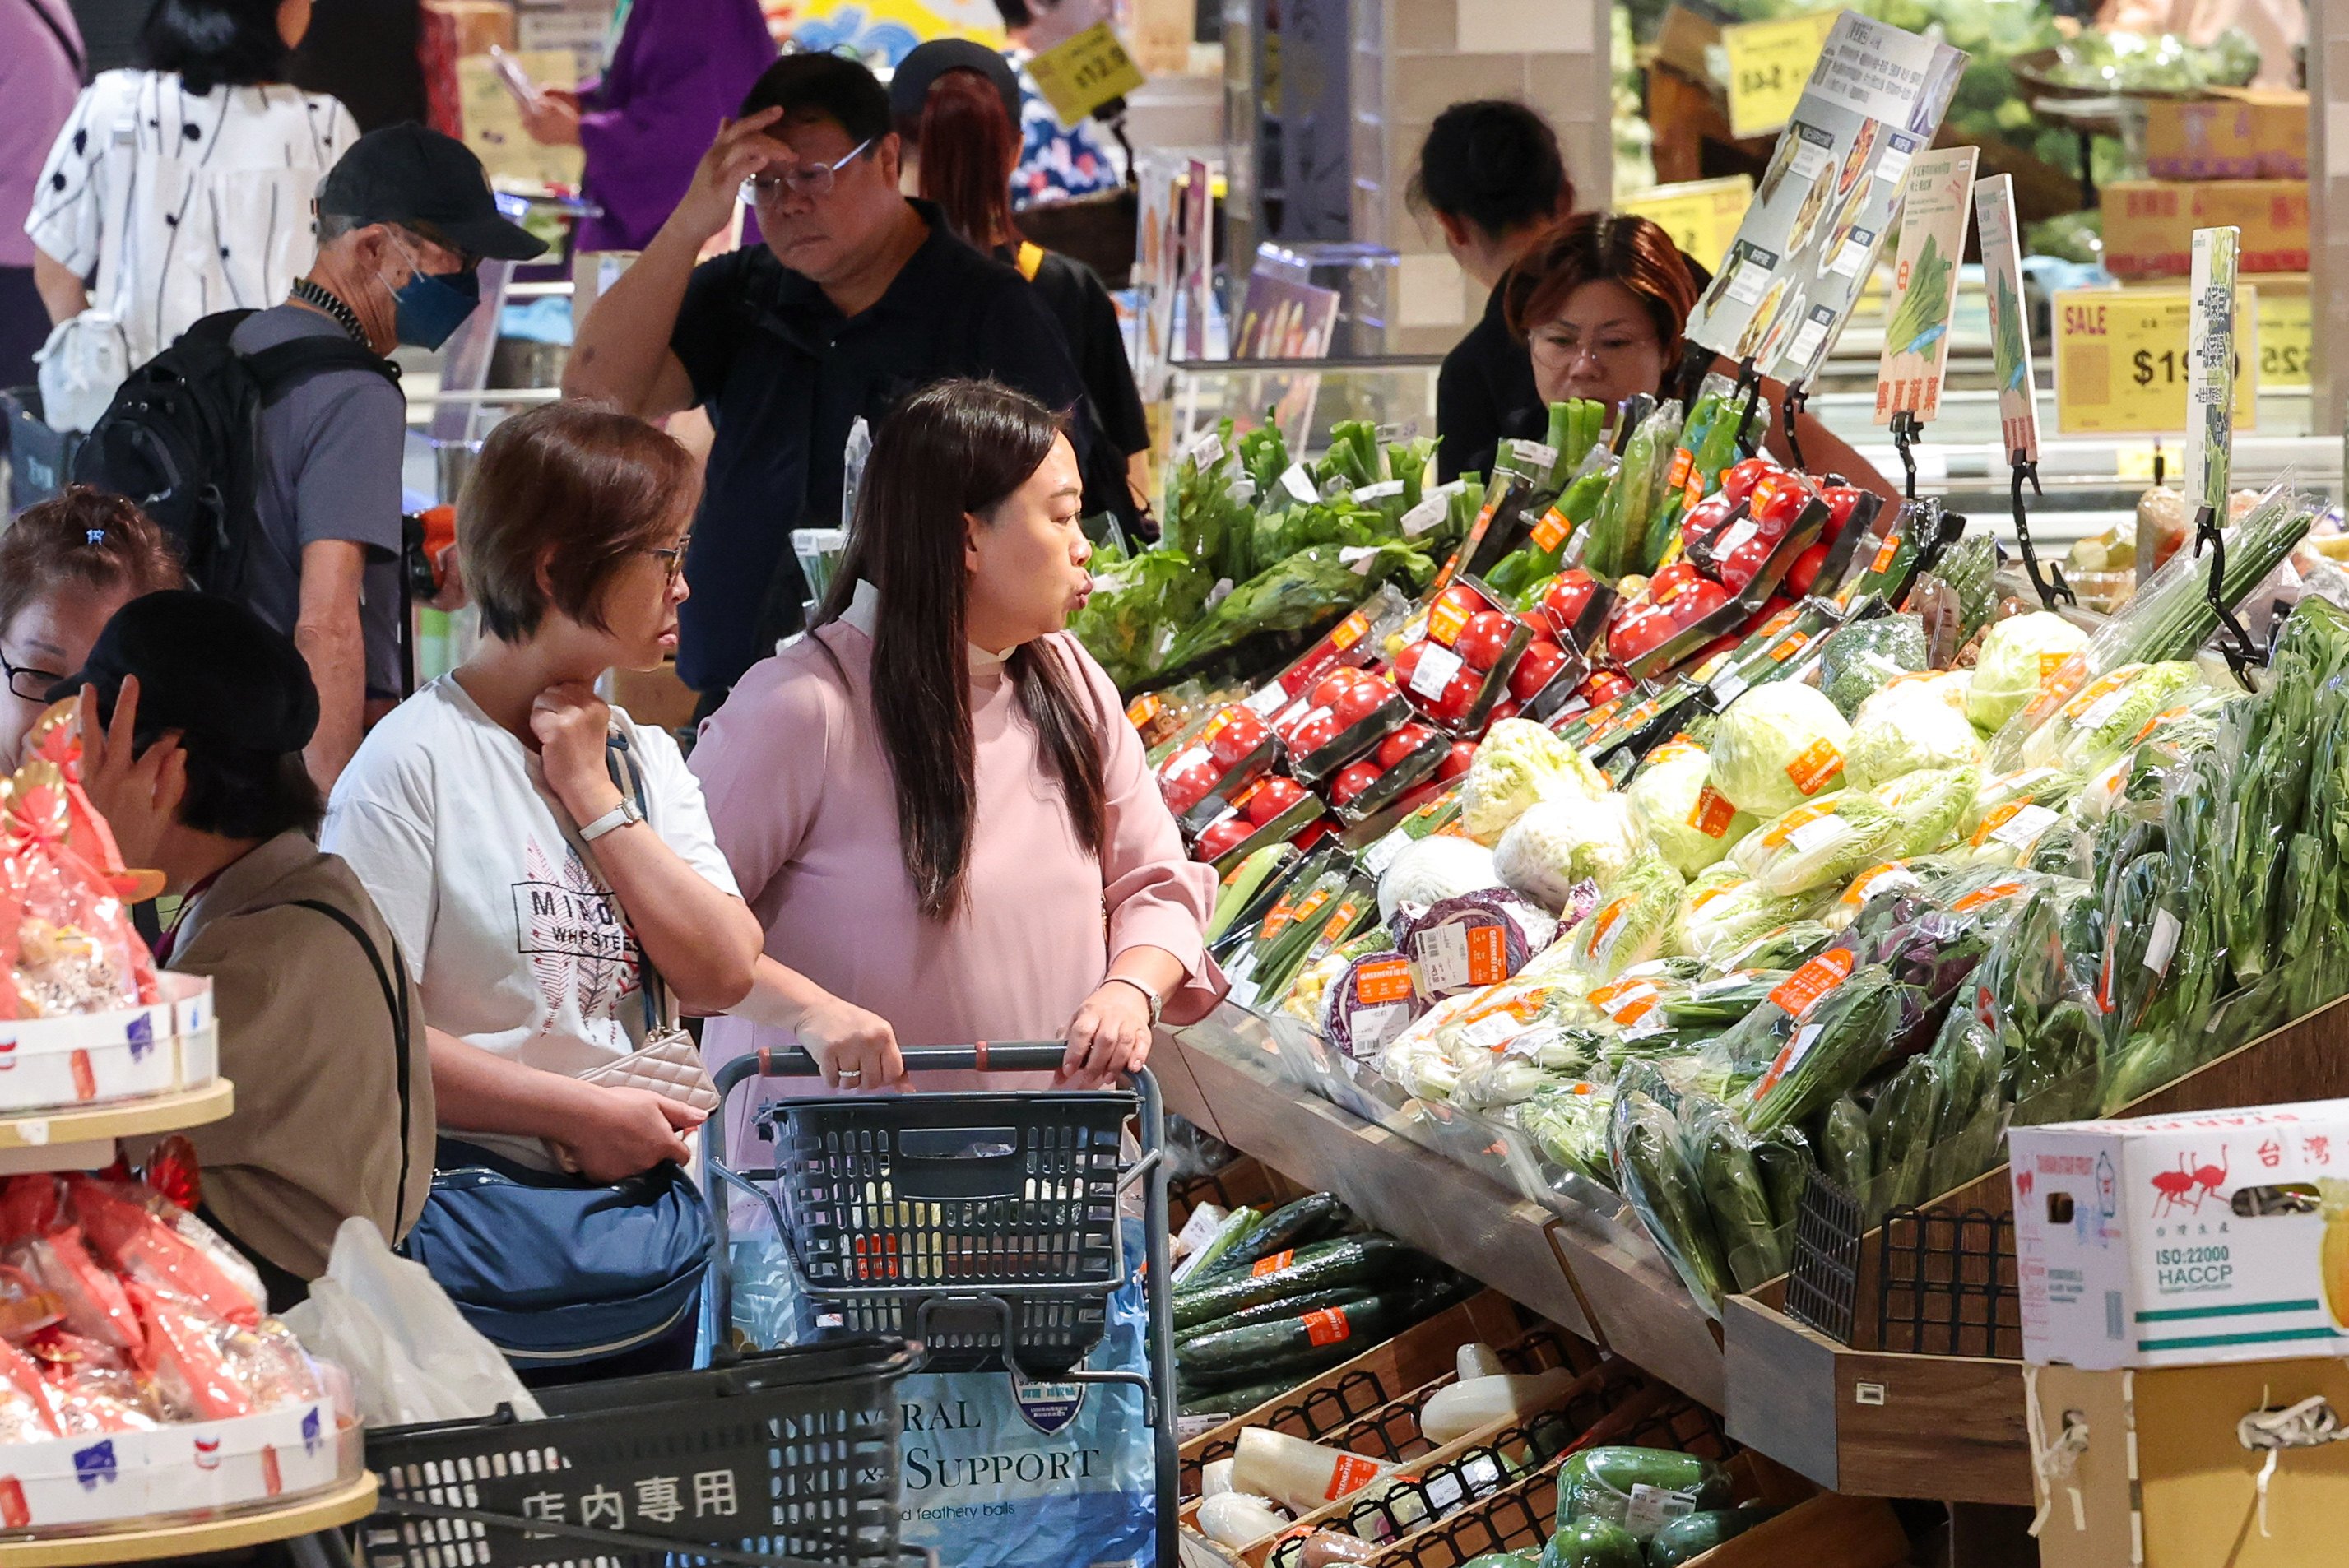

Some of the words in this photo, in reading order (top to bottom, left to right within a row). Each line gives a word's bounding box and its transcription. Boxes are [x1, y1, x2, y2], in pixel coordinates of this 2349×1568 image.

[2065, 305, 2107, 336] SALE
[2157, 1264, 2234, 1286] HACCP
[522, 1468, 739, 1540] 店內專用
[917, 1504, 977, 1522] feathery
[982, 1501, 1016, 1518] balls
